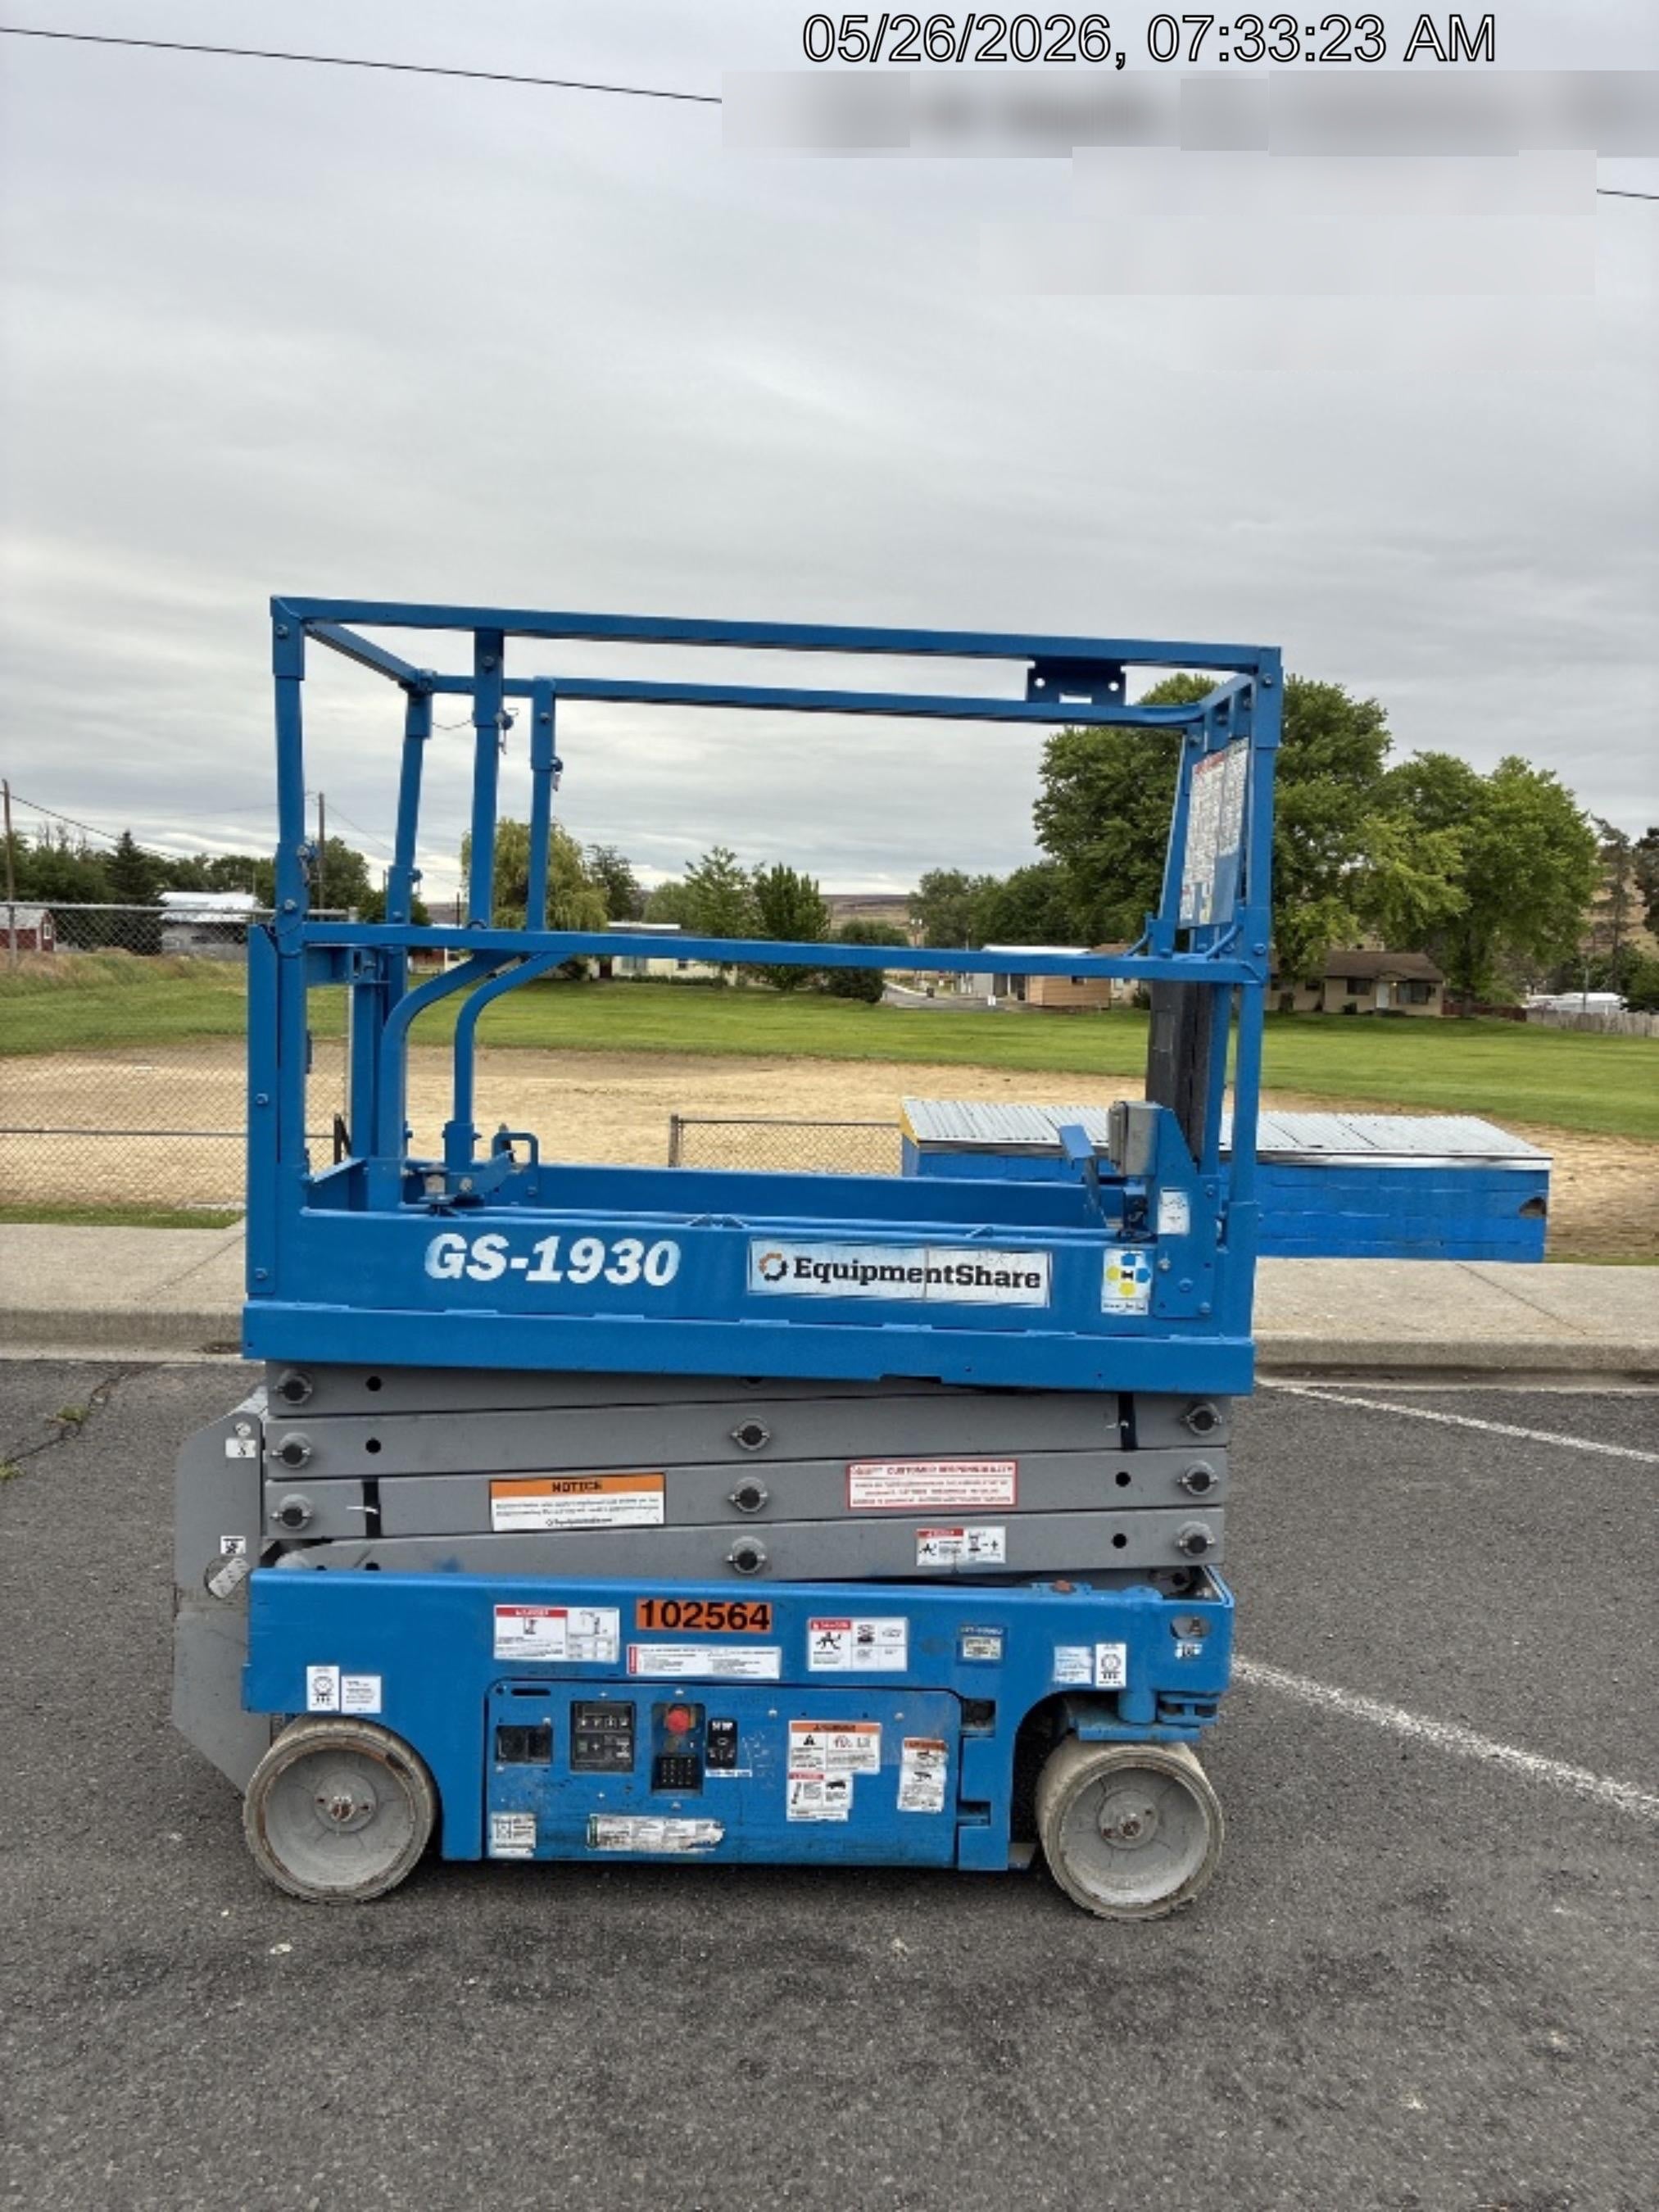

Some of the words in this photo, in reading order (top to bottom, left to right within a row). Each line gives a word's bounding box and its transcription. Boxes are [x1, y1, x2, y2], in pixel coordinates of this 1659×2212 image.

[424, 1232, 682, 1287] GS-1930
[793, 1257, 1041, 1290] EquipmentShare
[640, 1599, 770, 1630] 102564
